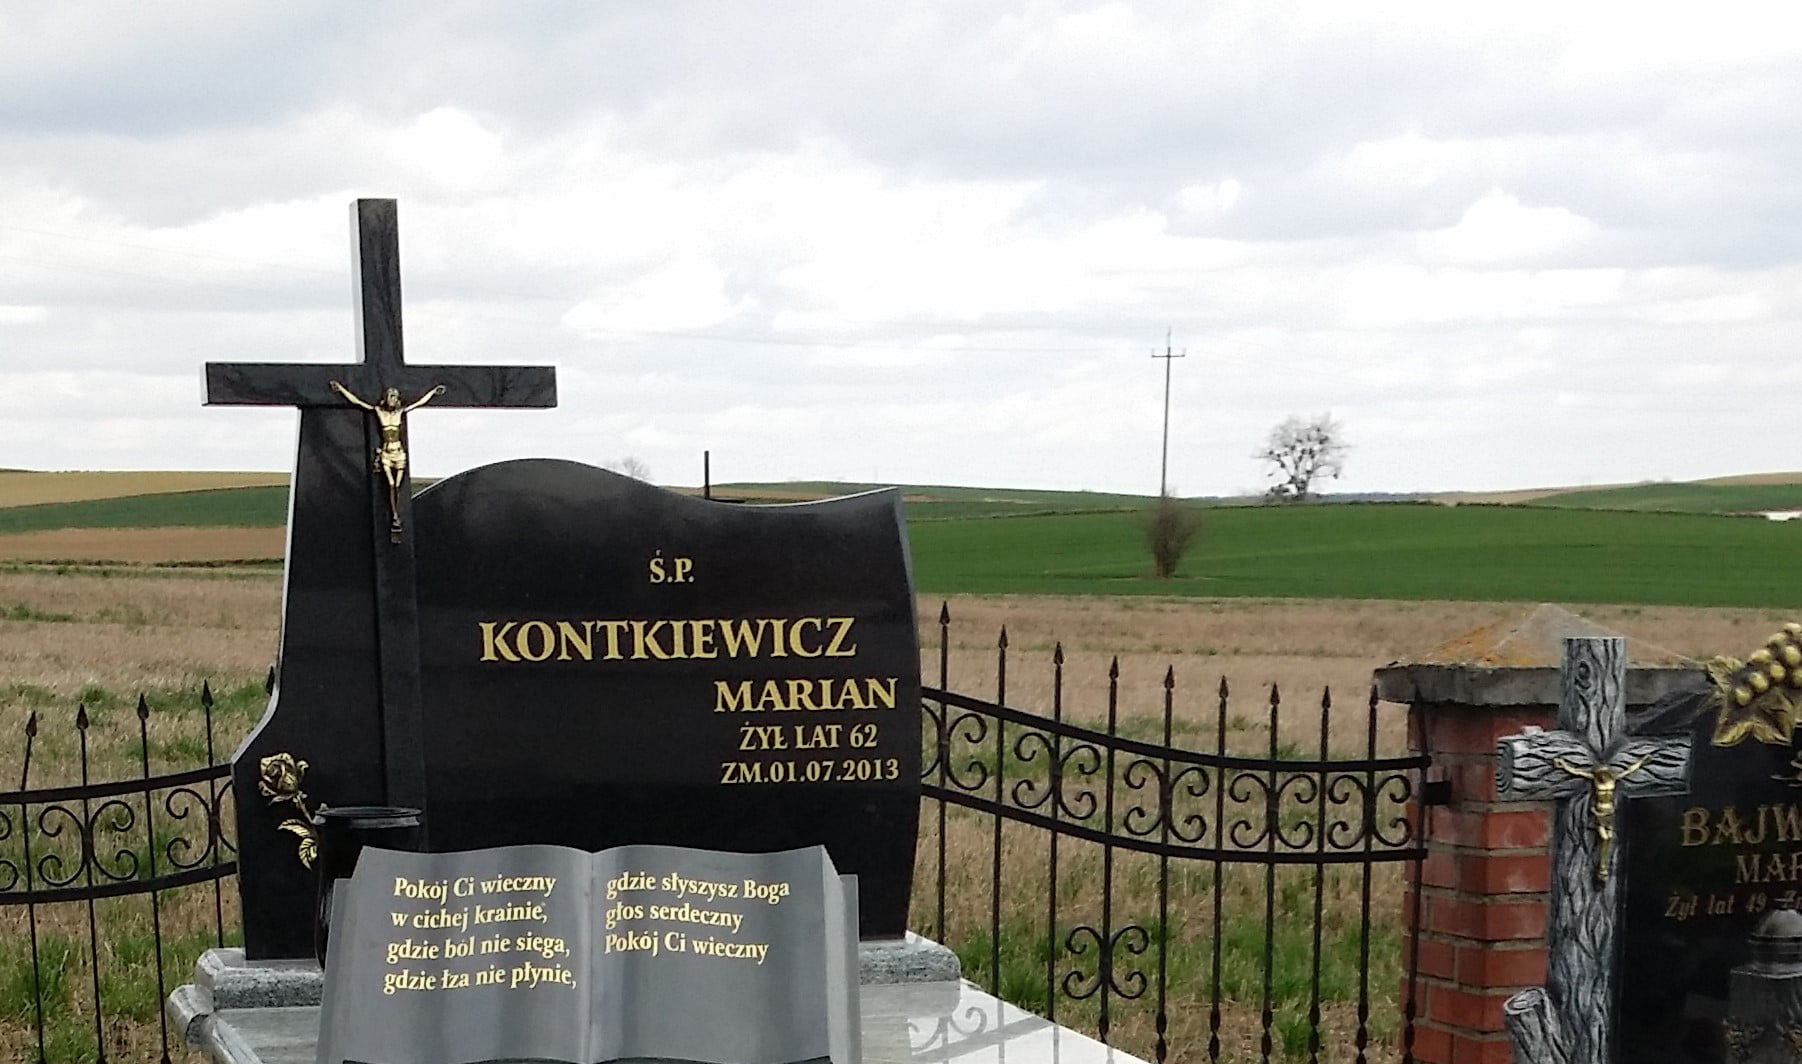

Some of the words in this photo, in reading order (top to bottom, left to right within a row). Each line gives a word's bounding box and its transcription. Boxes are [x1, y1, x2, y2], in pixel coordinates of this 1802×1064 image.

[650, 550, 695, 583] Ś.P.
[478, 617, 857, 662] KONTKIEWICZ
[713, 678, 898, 713] MARIAN
[739, 721, 788, 751] ŻYŁ
[795, 724, 842, 748] LAT
[850, 723, 878, 748] 62
[721, 759, 900, 784] ZM.01.07.2013
[393, 877, 448, 905] Pokój
[453, 876, 475, 897] Ci
[480, 873, 557, 898] wieczny
[606, 871, 657, 900] gdzie
[661, 872, 738, 902] słyszysz
[742, 879, 790, 905] Boga
[1707, 894, 1735, 915] lat
[390, 912, 408, 927] w
[412, 906, 469, 933] cichej
[474, 900, 548, 924] krainie,
[605, 901, 645, 930] głos
[649, 902, 743, 934] serdeczny
[386, 939, 440, 964] gdzie
[444, 935, 475, 959] ból
[480, 934, 511, 954] nie
[604, 931, 660, 957] Pokój
[664, 931, 687, 952] Ci
[692, 936, 770, 965] wieczny
[383, 969, 437, 996] gdzie
[441, 969, 470, 989] łza
[475, 964, 506, 986] nie
[510, 960, 577, 990] płynie,
